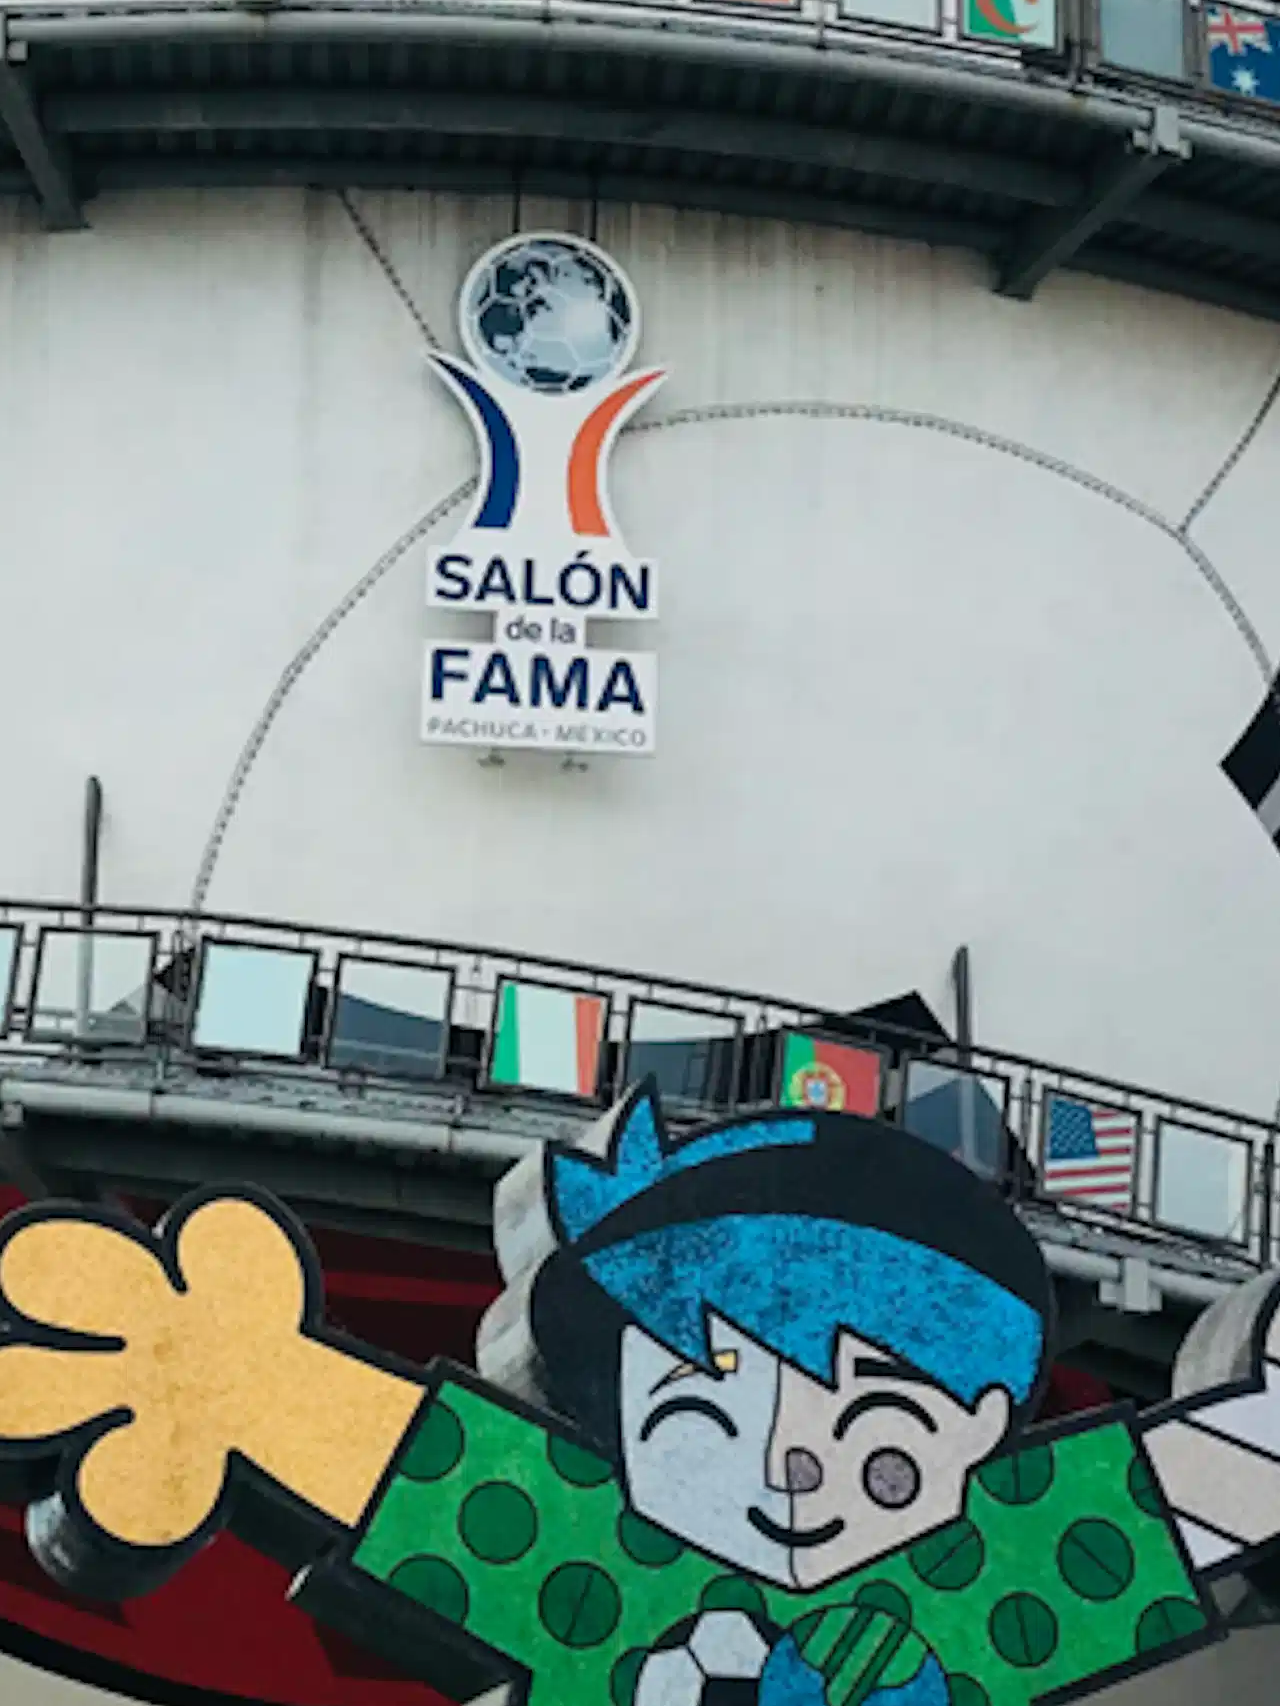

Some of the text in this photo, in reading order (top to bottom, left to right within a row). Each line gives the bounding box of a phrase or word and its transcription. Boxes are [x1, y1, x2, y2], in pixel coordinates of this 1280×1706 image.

[435, 550, 649, 611] SALÓN
[505, 615, 577, 644] de la
[431, 649, 645, 714] FAMA
[426, 717, 538, 740] PACHUCA
